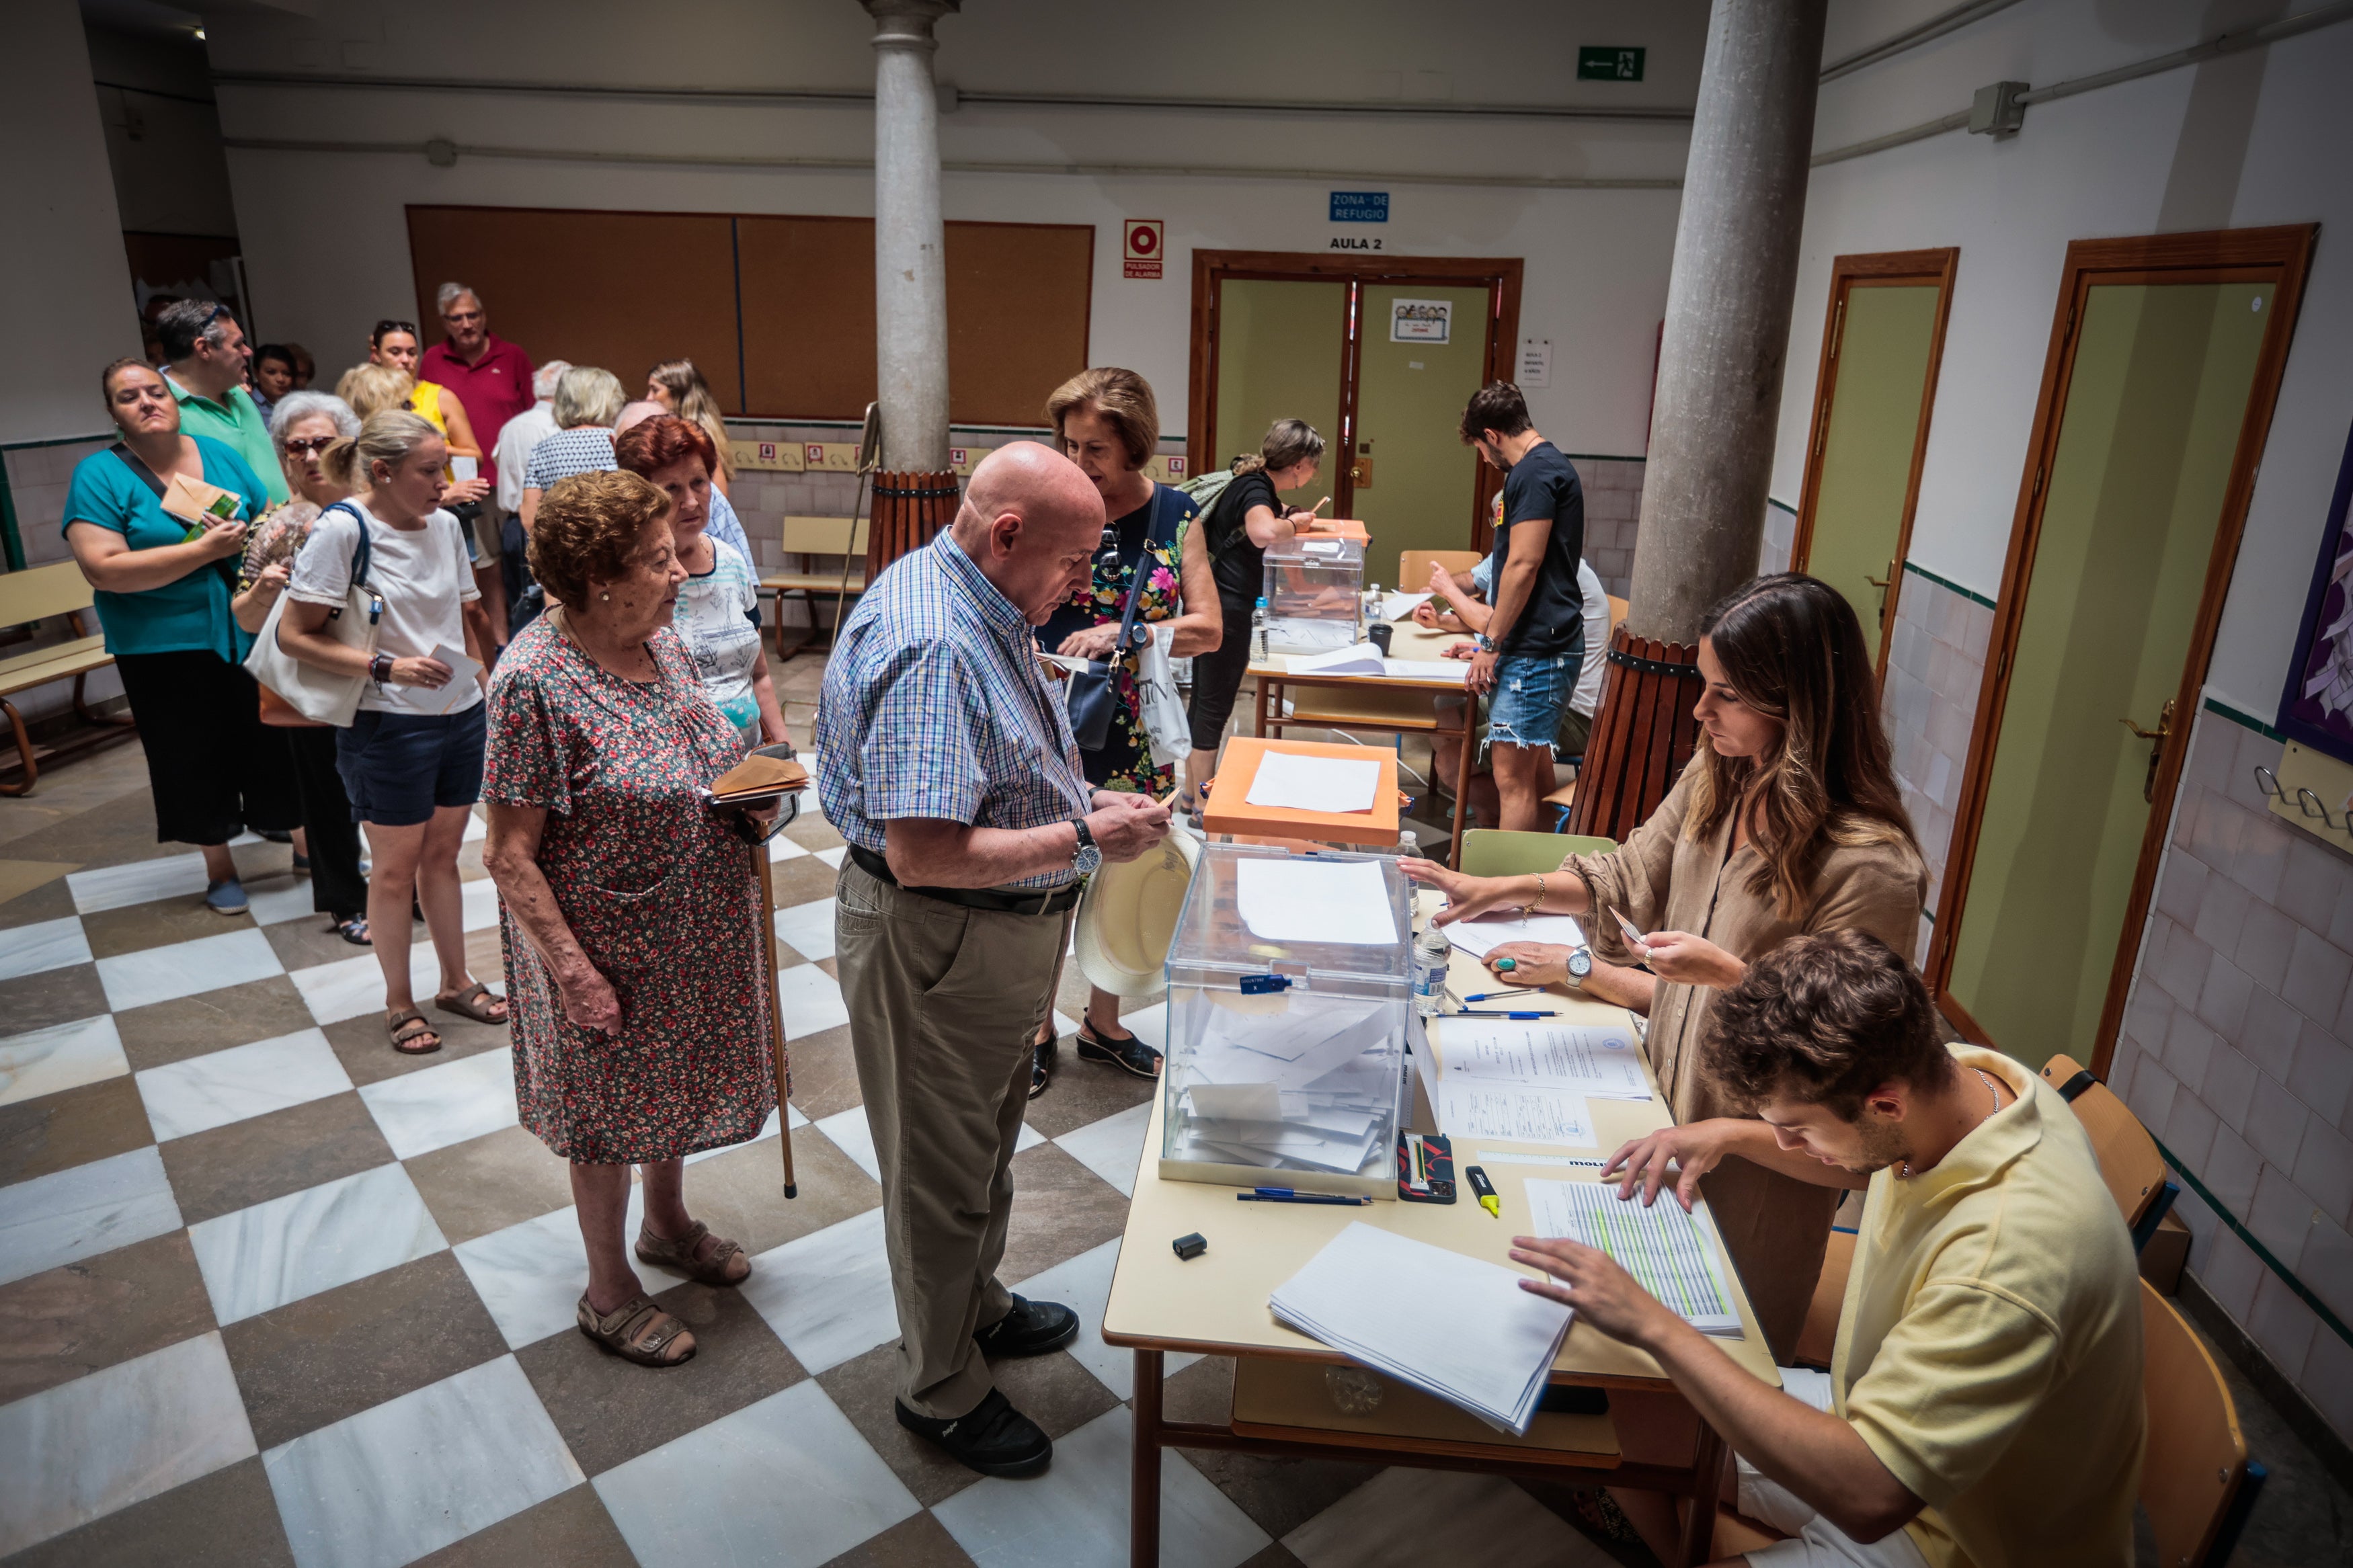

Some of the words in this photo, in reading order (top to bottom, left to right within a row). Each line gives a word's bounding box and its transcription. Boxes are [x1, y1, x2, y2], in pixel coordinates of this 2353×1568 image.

[1333, 195, 1365, 204] ZONA
[1373, 196, 1388, 206] DE
[1335, 208, 1385, 219] REFUGIO
[1330, 238, 1369, 249] AULA
[1373, 239, 1382, 249] 2
